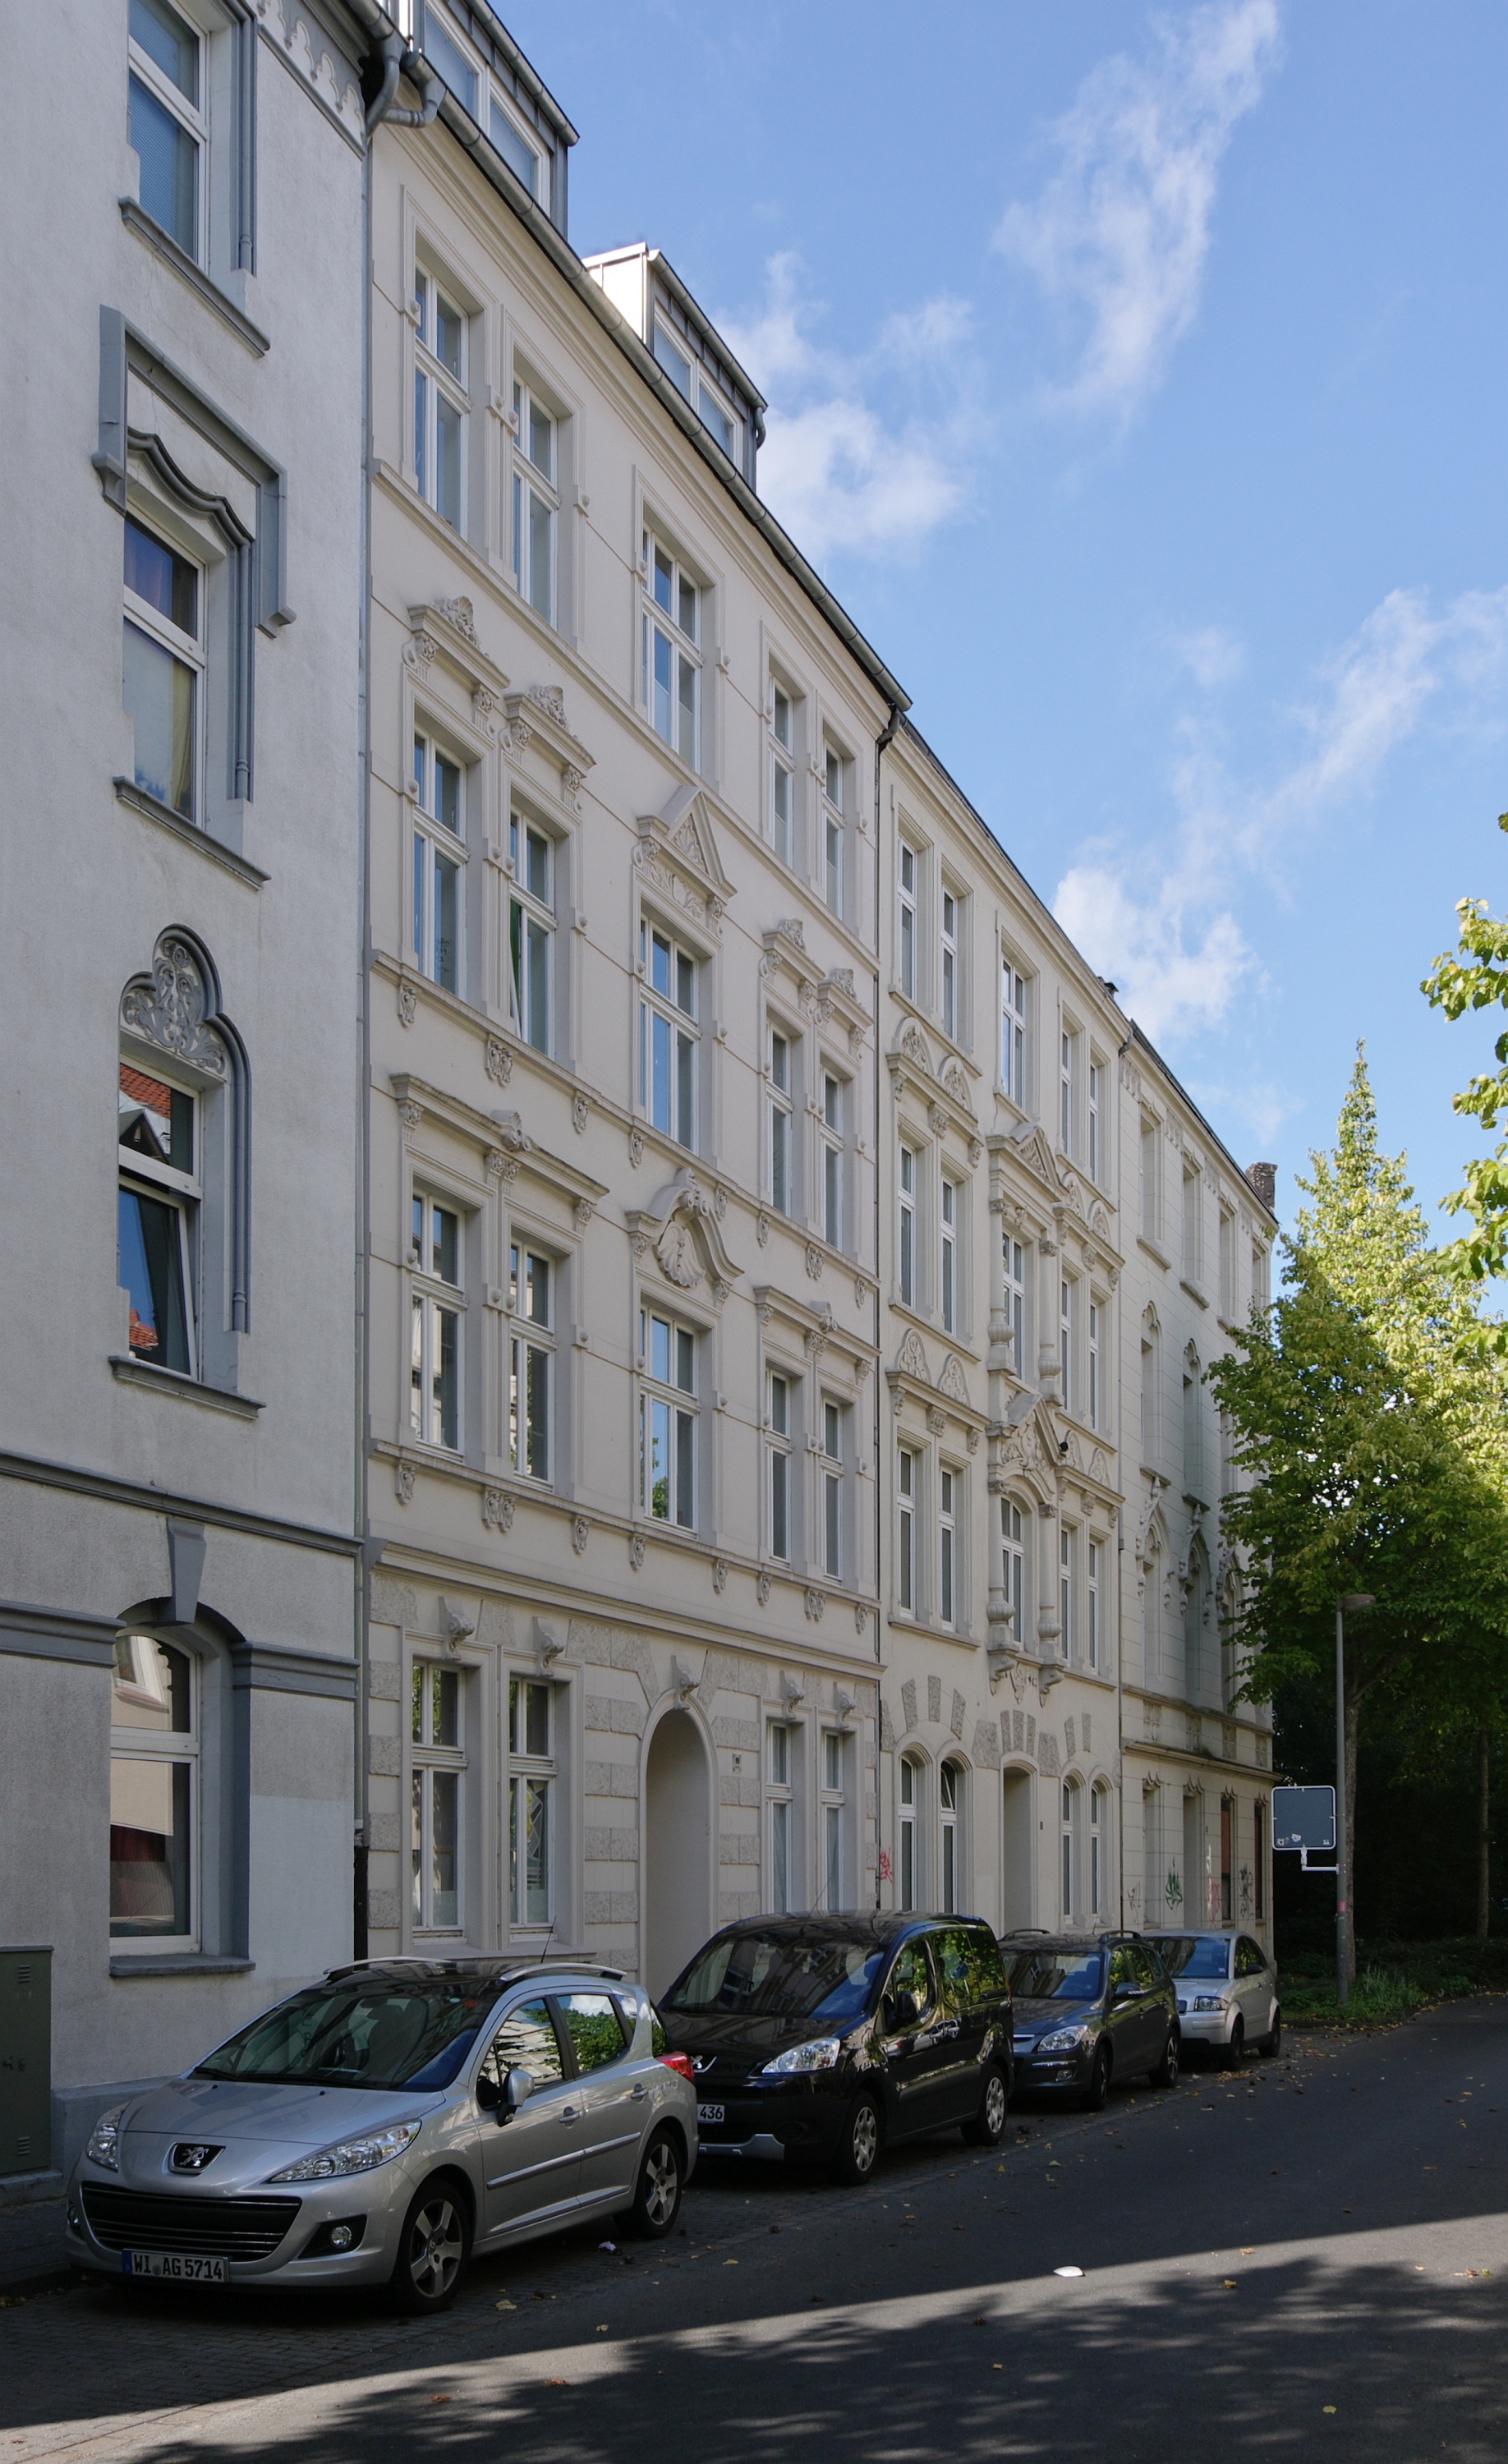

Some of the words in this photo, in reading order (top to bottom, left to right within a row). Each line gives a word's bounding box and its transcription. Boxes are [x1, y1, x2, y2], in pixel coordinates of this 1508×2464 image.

[700, 2106, 723, 2120] 436
[133, 2254, 151, 2274] WI
[163, 2256, 182, 2277] AG
[184, 2259, 223, 2280] 5714
